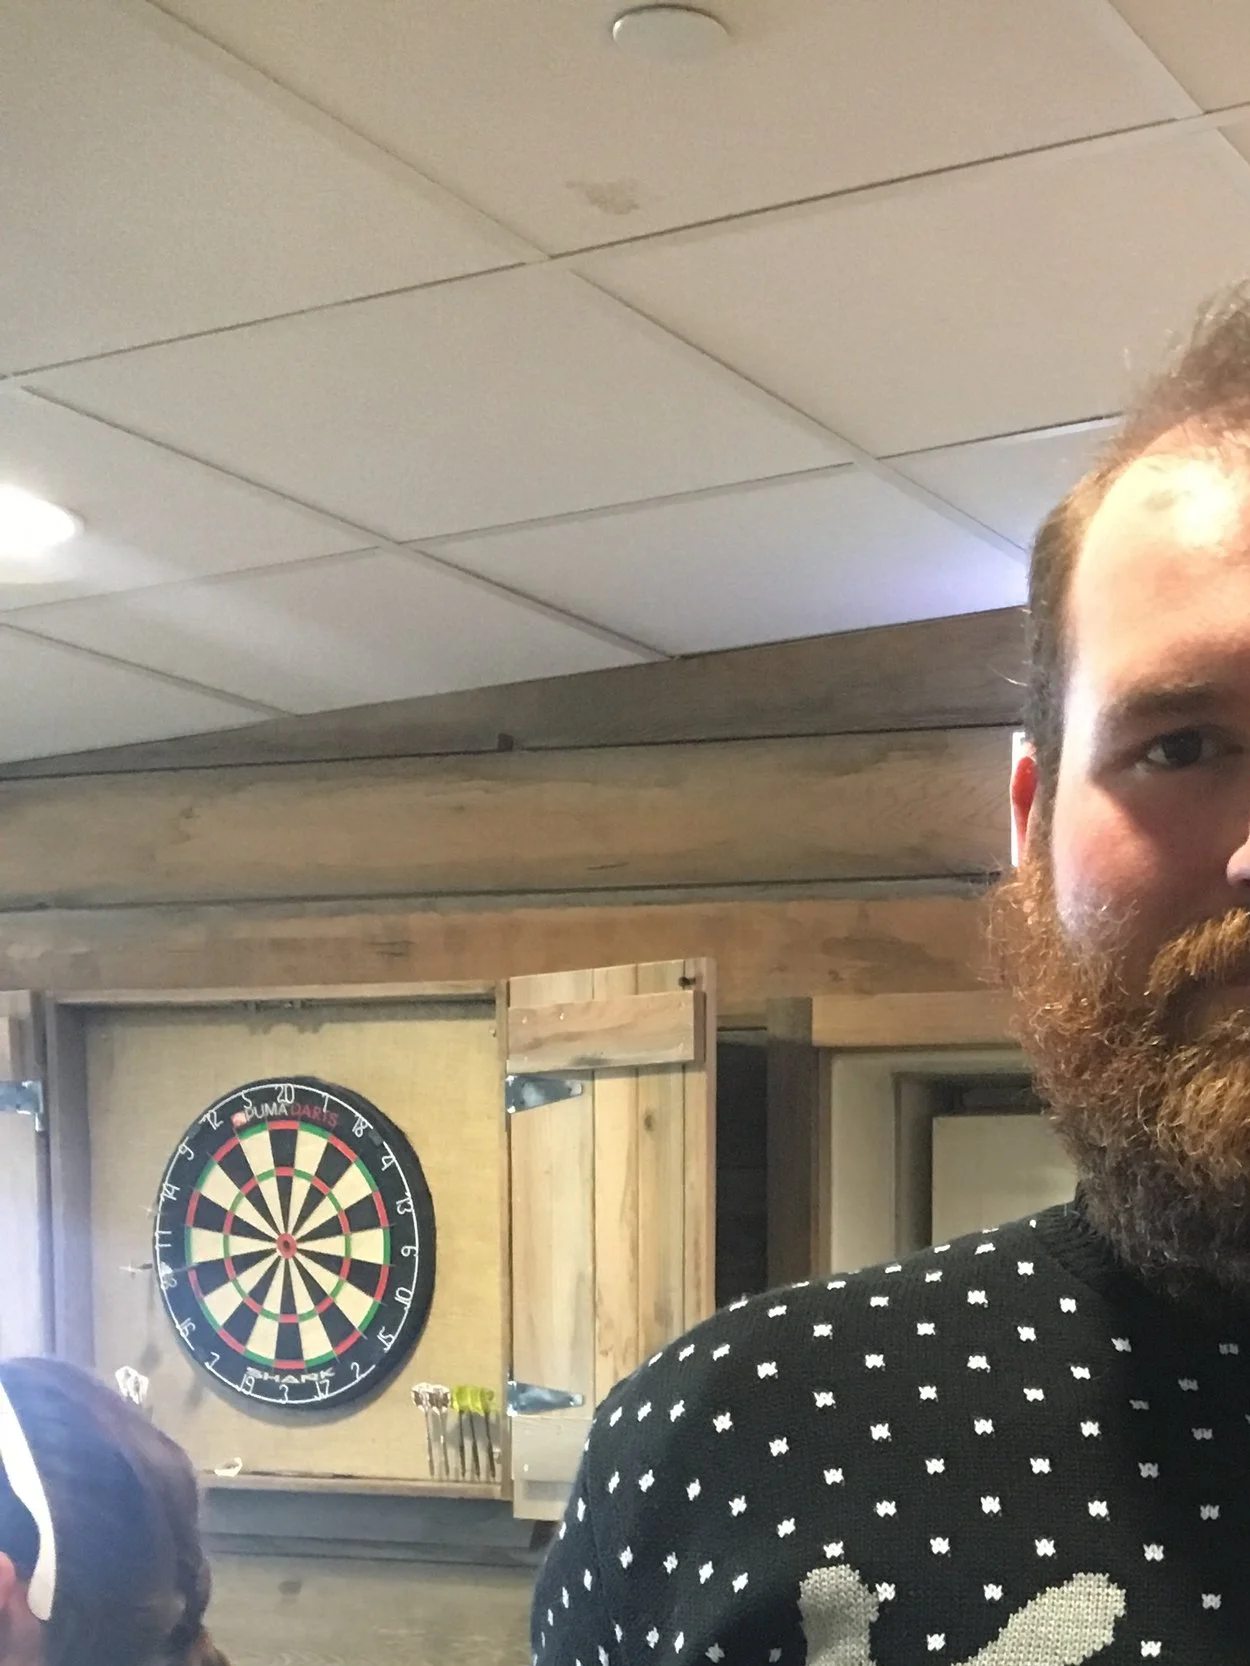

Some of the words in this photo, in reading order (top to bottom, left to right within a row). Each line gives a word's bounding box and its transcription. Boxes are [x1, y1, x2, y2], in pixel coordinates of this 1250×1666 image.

[241, 1090, 252, 1109] 5
[275, 1084, 295, 1104] 20
[202, 1110, 224, 1130] 12
[352, 1114, 369, 1137] 18
[381, 1155, 396, 1171] 4
[160, 1183, 180, 1201] 14
[396, 1193, 413, 1215] 13
[156, 1230, 172, 1247] 11
[395, 1287, 413, 1310] 10
[377, 1326, 396, 1352] 15
[351, 1362, 362, 1382] 2
[237, 1374, 255, 1394] 19
[279, 1384, 289, 1404] 3
[315, 1379, 330, 1399] 17
